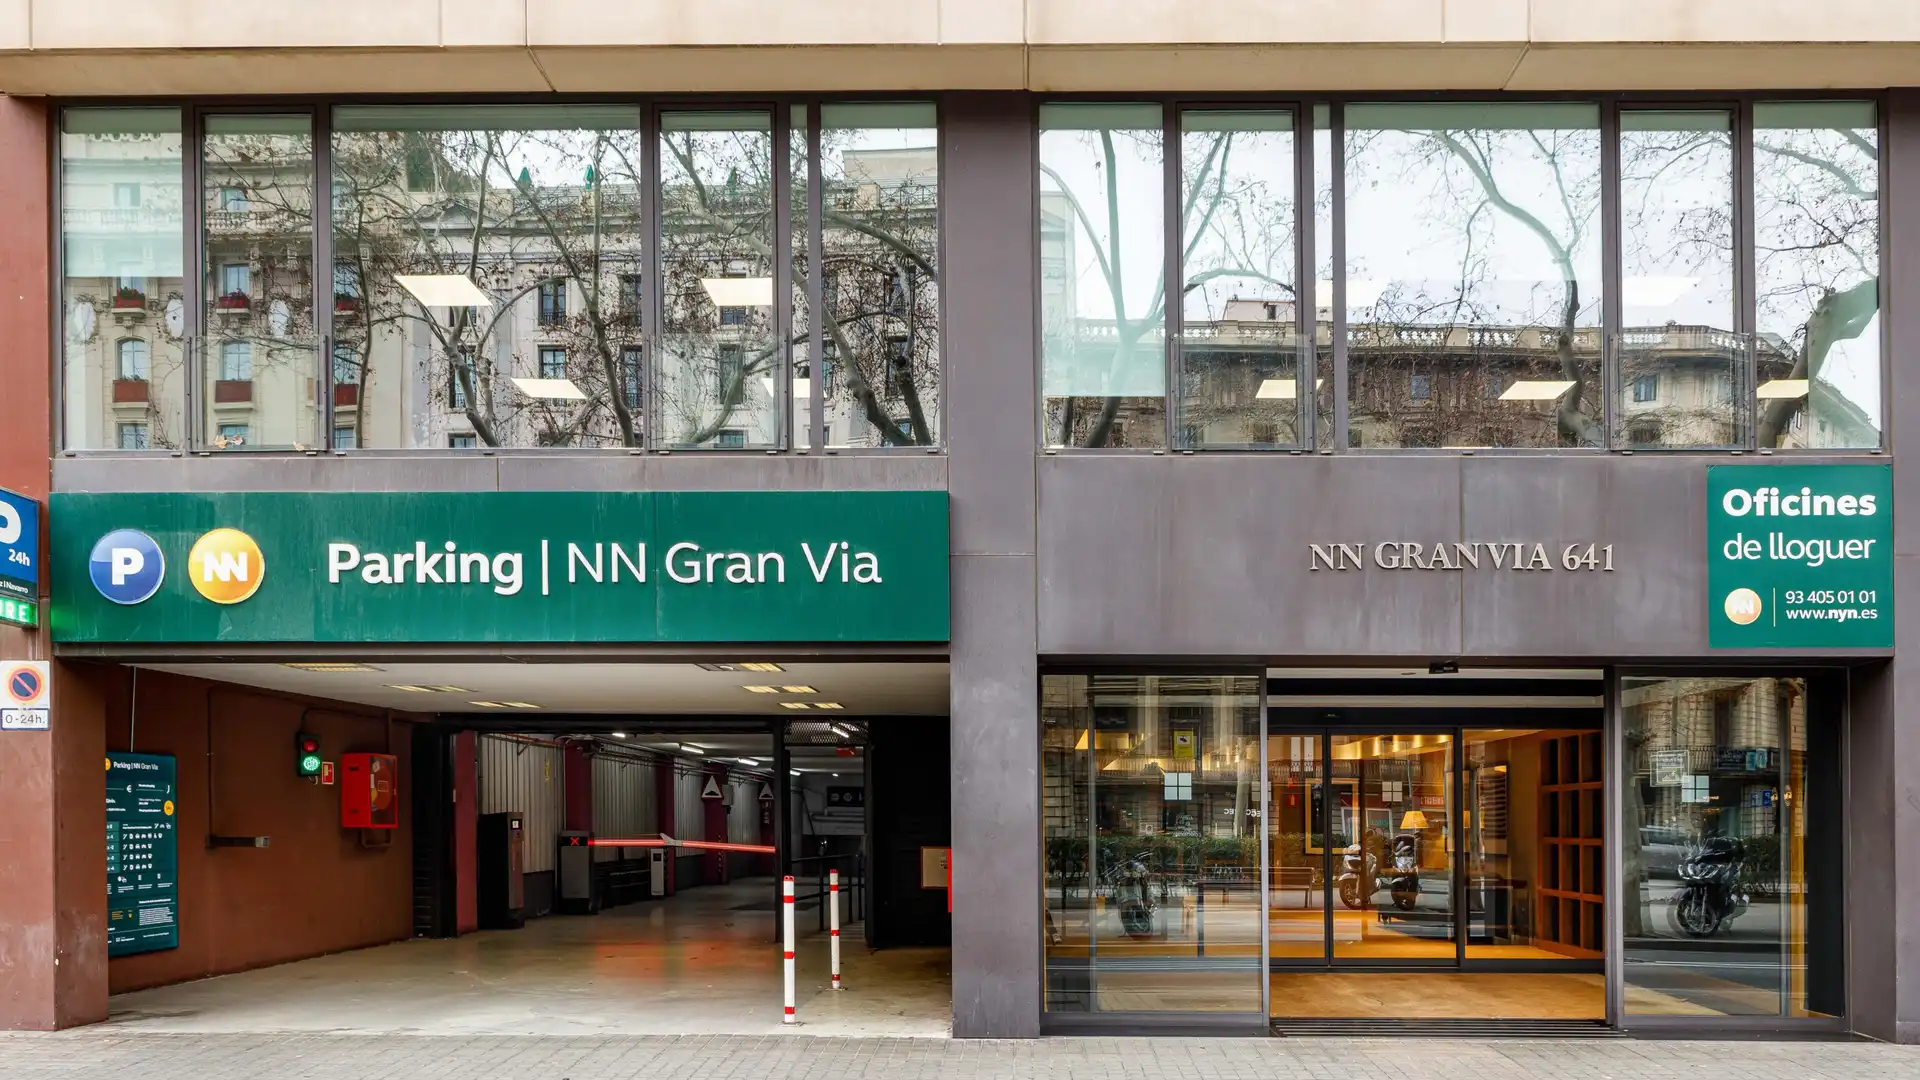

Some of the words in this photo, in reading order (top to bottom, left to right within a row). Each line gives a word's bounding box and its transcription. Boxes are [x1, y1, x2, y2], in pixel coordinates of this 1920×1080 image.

[1722, 487, 1877, 517] Oficines
[8, 548, 31, 567] 24h
[1308, 543, 1365, 570] NN
[1562, 543, 1614, 571] 641
[1723, 532, 1762, 560] de
[1769, 532, 1877, 567] lloguer
[111, 547, 145, 585] P
[203, 551, 248, 582] NN
[328, 541, 524, 595] Parking
[567, 543, 647, 583] NN
[665, 542, 785, 583] Gran
[800, 541, 883, 583] Via
[1785, 590, 1804, 604] 93
[1807, 590, 1835, 604] 405
[1837, 590, 1855, 604] 01
[1858, 590, 1876, 604] 01
[1786, 608, 1878, 623] www.nyn.es
